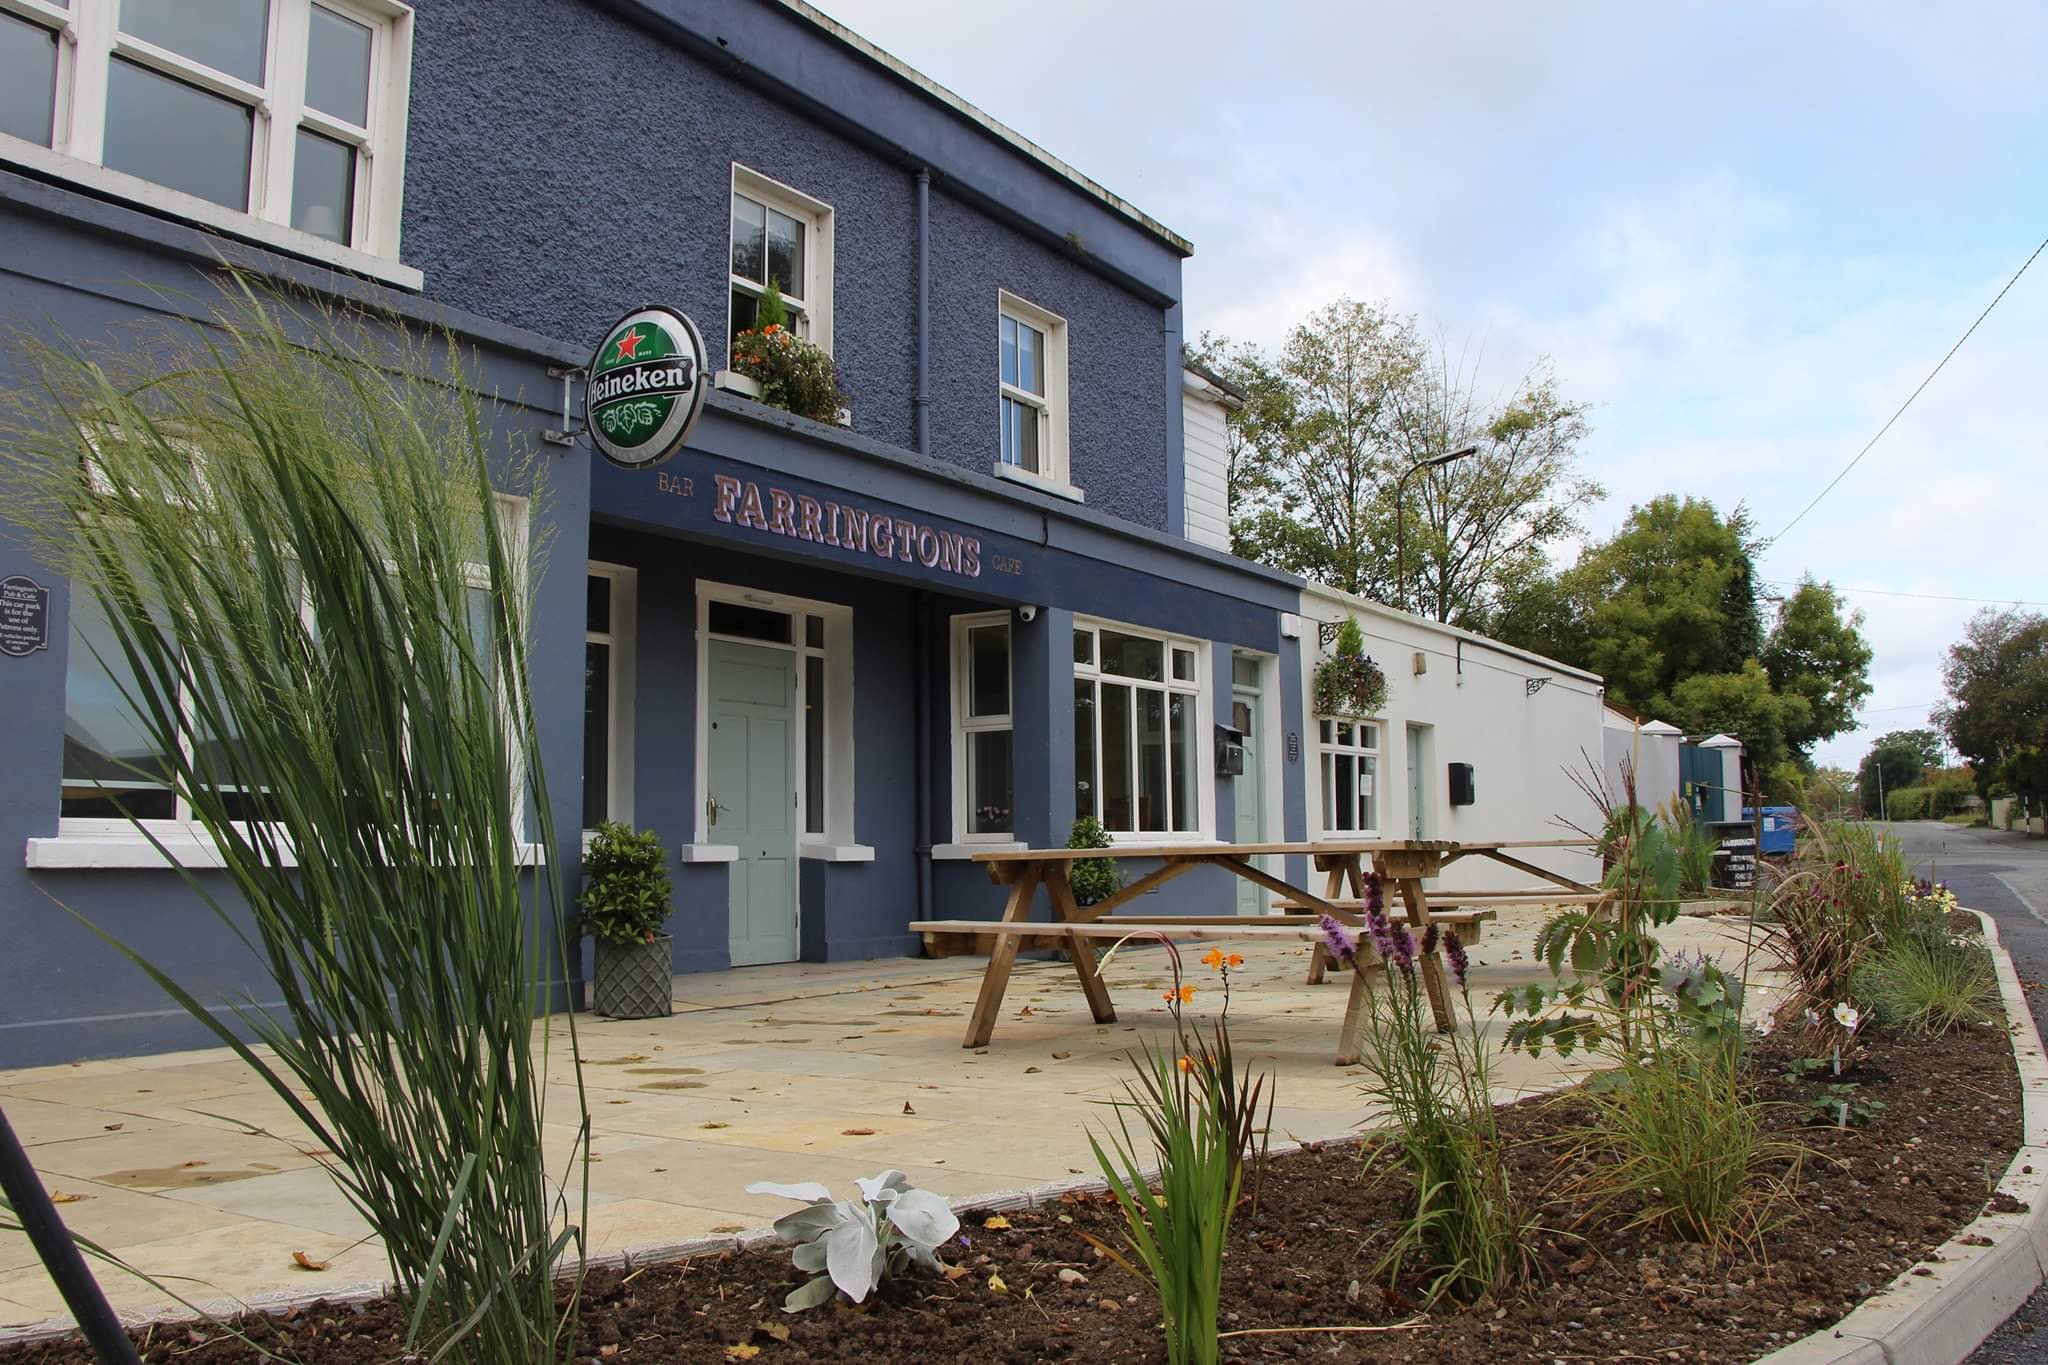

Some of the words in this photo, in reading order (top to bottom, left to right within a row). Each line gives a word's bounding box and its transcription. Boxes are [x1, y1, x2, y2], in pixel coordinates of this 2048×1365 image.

[590, 366, 685, 403] Heineken
[656, 471, 694, 497] BAR
[712, 473, 981, 578] FARRINGTONS
[4, 590, 16, 598] Pub
[25, 603, 40, 612] park
